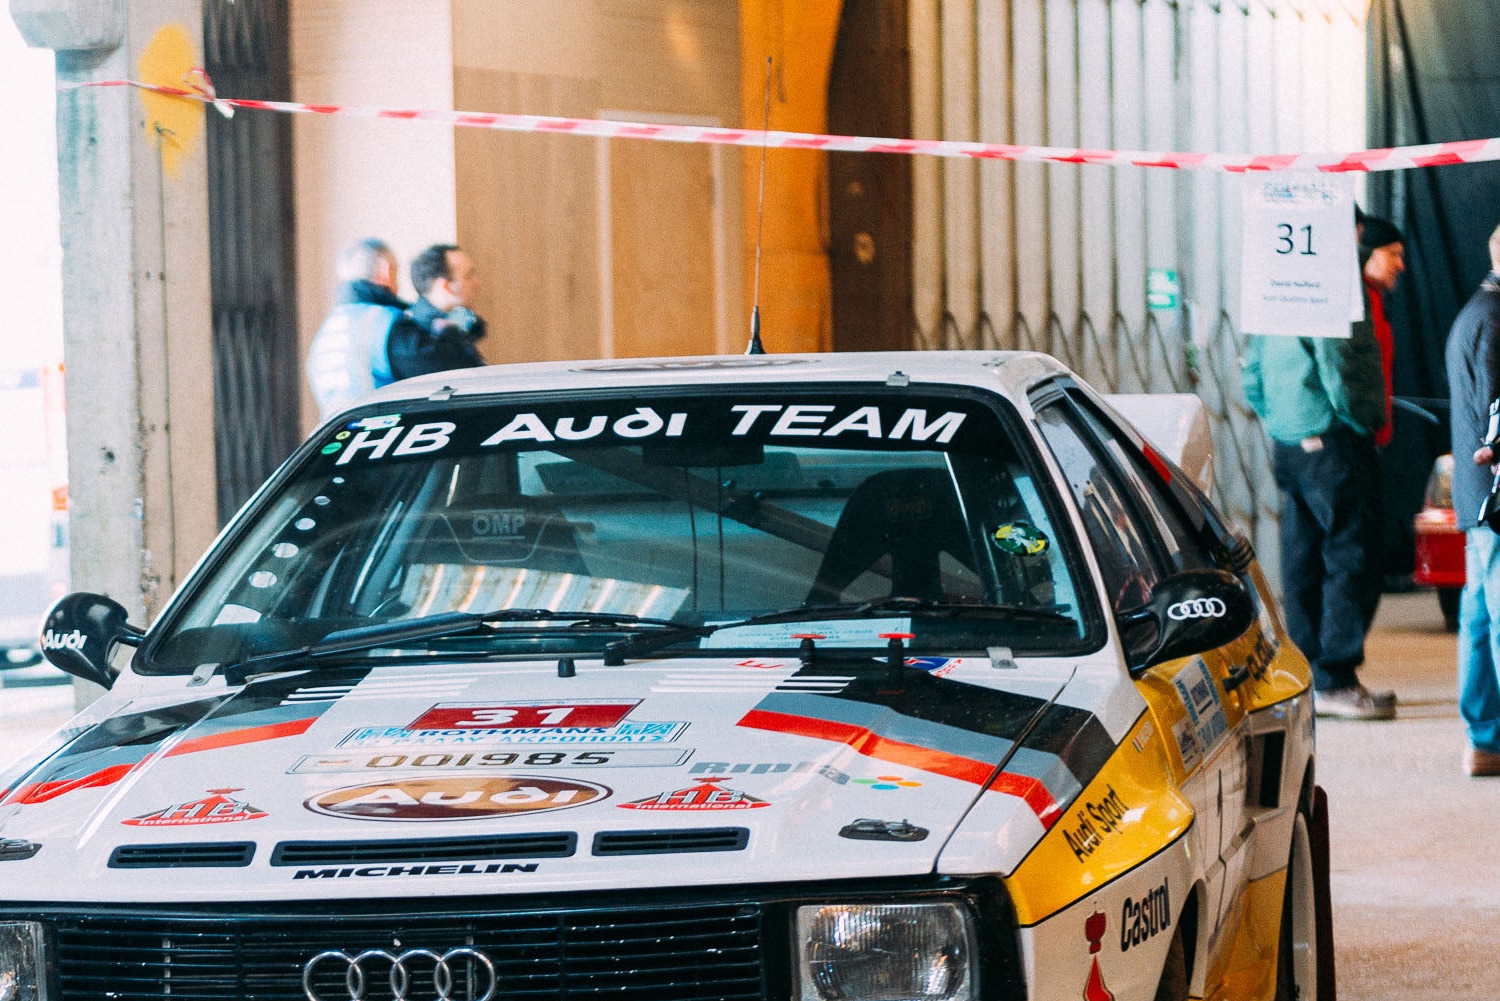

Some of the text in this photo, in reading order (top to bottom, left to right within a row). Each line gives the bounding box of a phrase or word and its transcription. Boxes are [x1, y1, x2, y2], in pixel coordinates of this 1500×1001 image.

[1276, 223, 1316, 255] 31
[335, 404, 967, 466] HB Audi TEAM
[43, 628, 87, 651] Audi
[455, 707, 576, 727] 31
[418, 726, 609, 738] ROTHMANS
[328, 786, 579, 809] Audi
[293, 863, 540, 879] MICHELIN
[1120, 876, 1171, 952] Castrol
